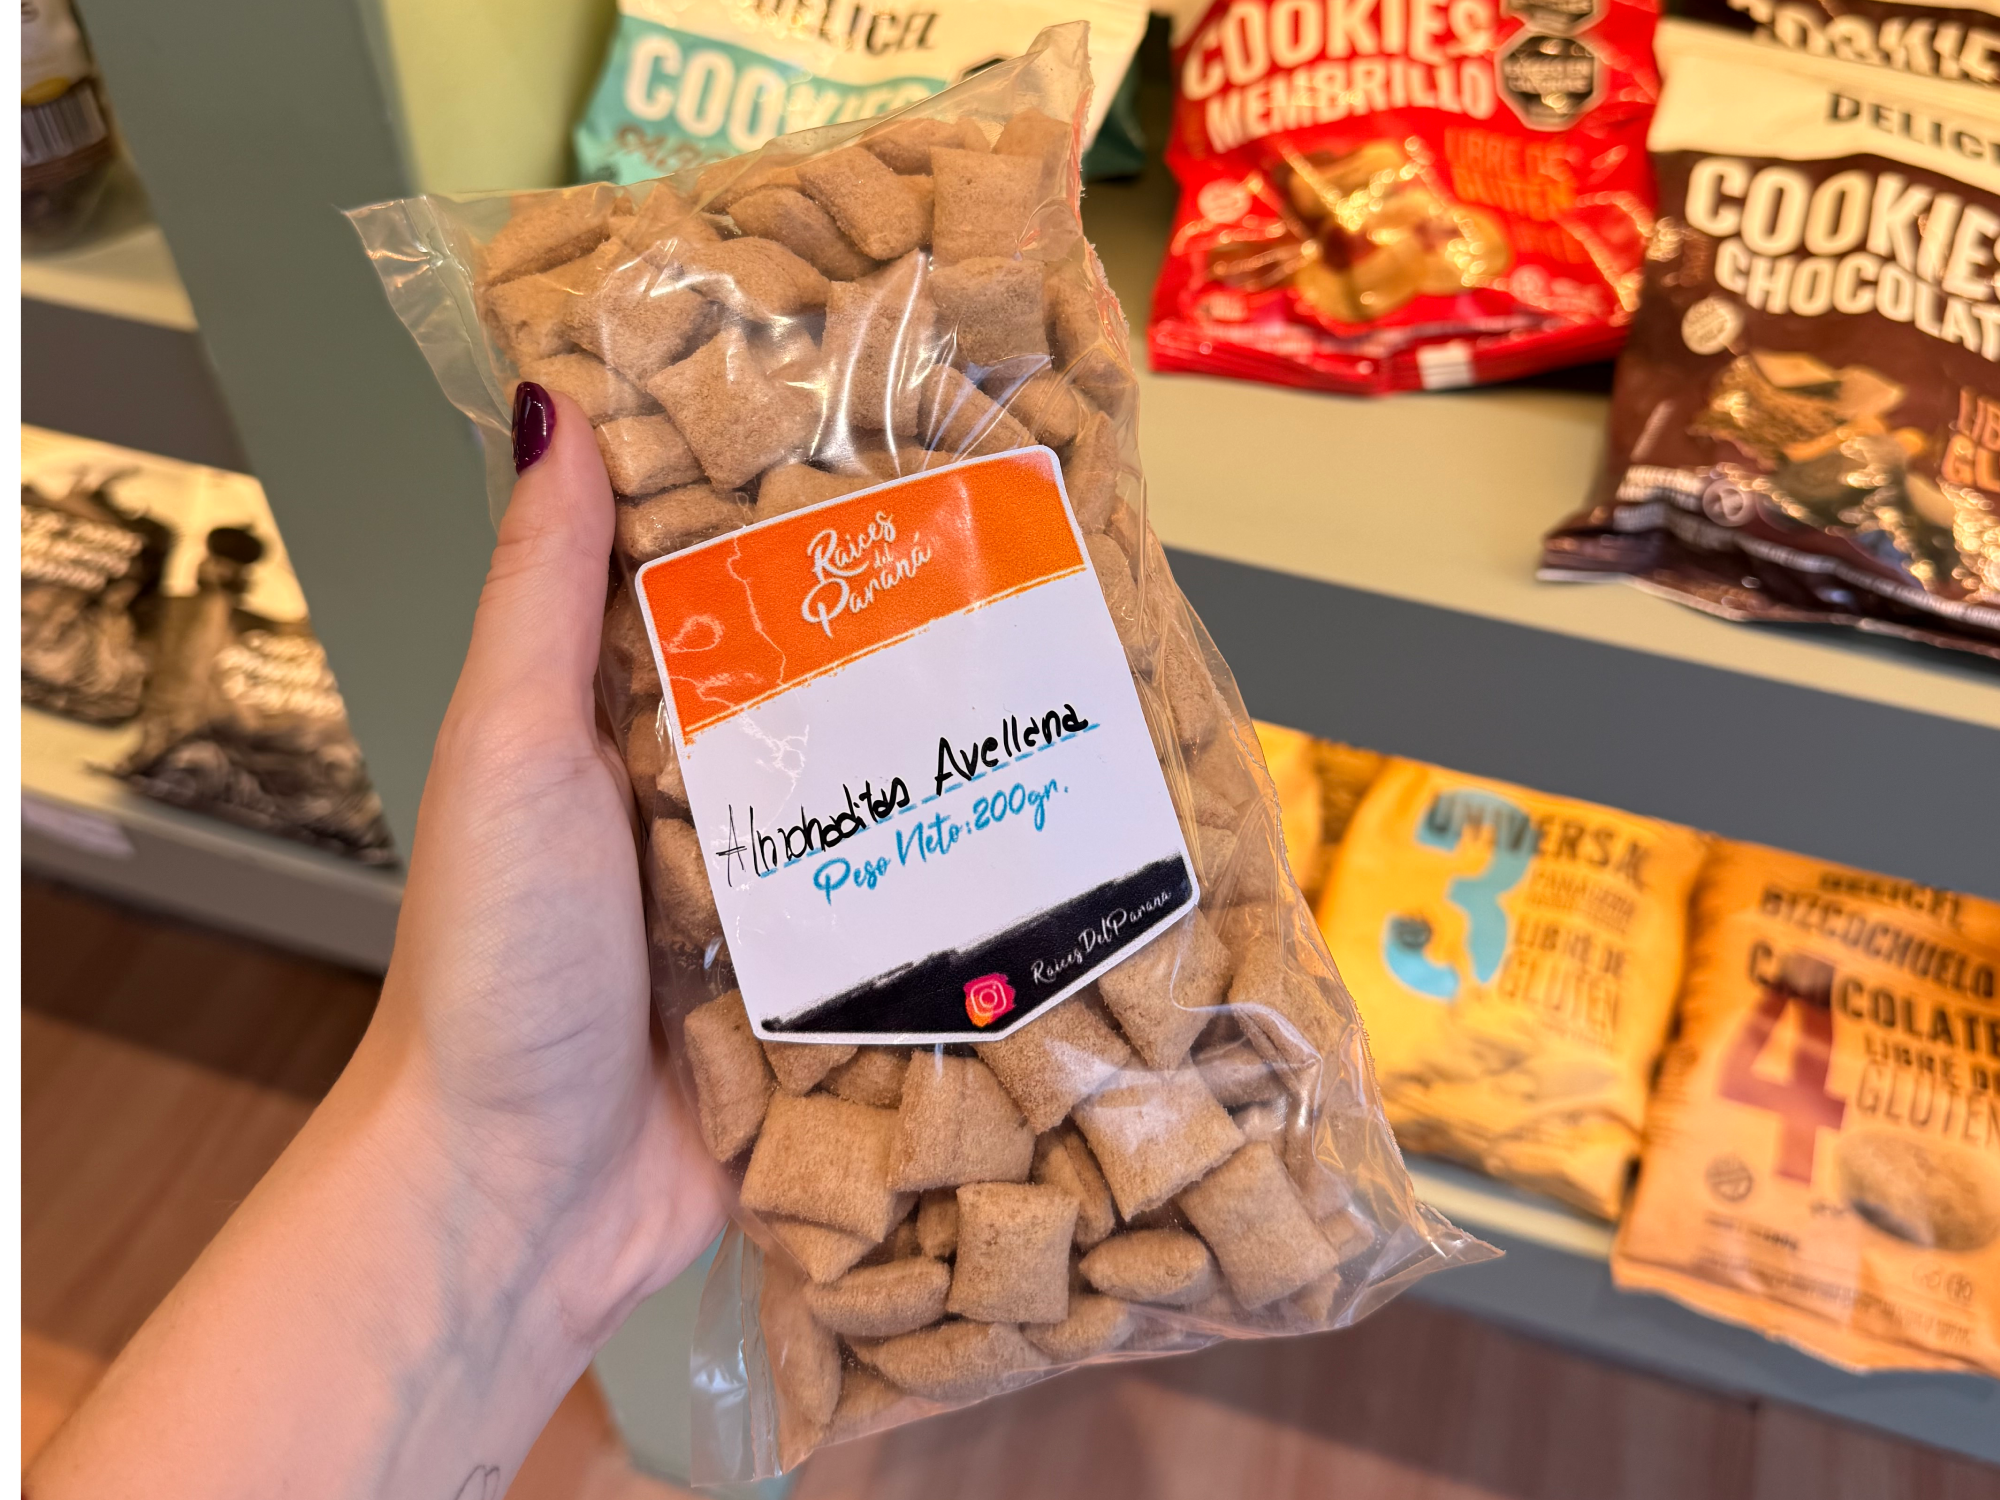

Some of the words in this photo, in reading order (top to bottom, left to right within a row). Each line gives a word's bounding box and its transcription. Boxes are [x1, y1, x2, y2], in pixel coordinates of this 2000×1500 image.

[624, 33, 934, 152] COOK
[1182, 0, 1495, 99] COOKIES
[1206, 56, 1499, 154] MEMBRILLO
[1685, 156, 2000, 301] COOKIE
[1715, 238, 2000, 362] CHOCOLAT
[801, 531, 931, 640] Paraná
[935, 704, 1089, 796] Avellana
[813, 853, 891, 906] Peso
[1384, 787, 1538, 1002] 3
[1718, 950, 1846, 1187] 4
